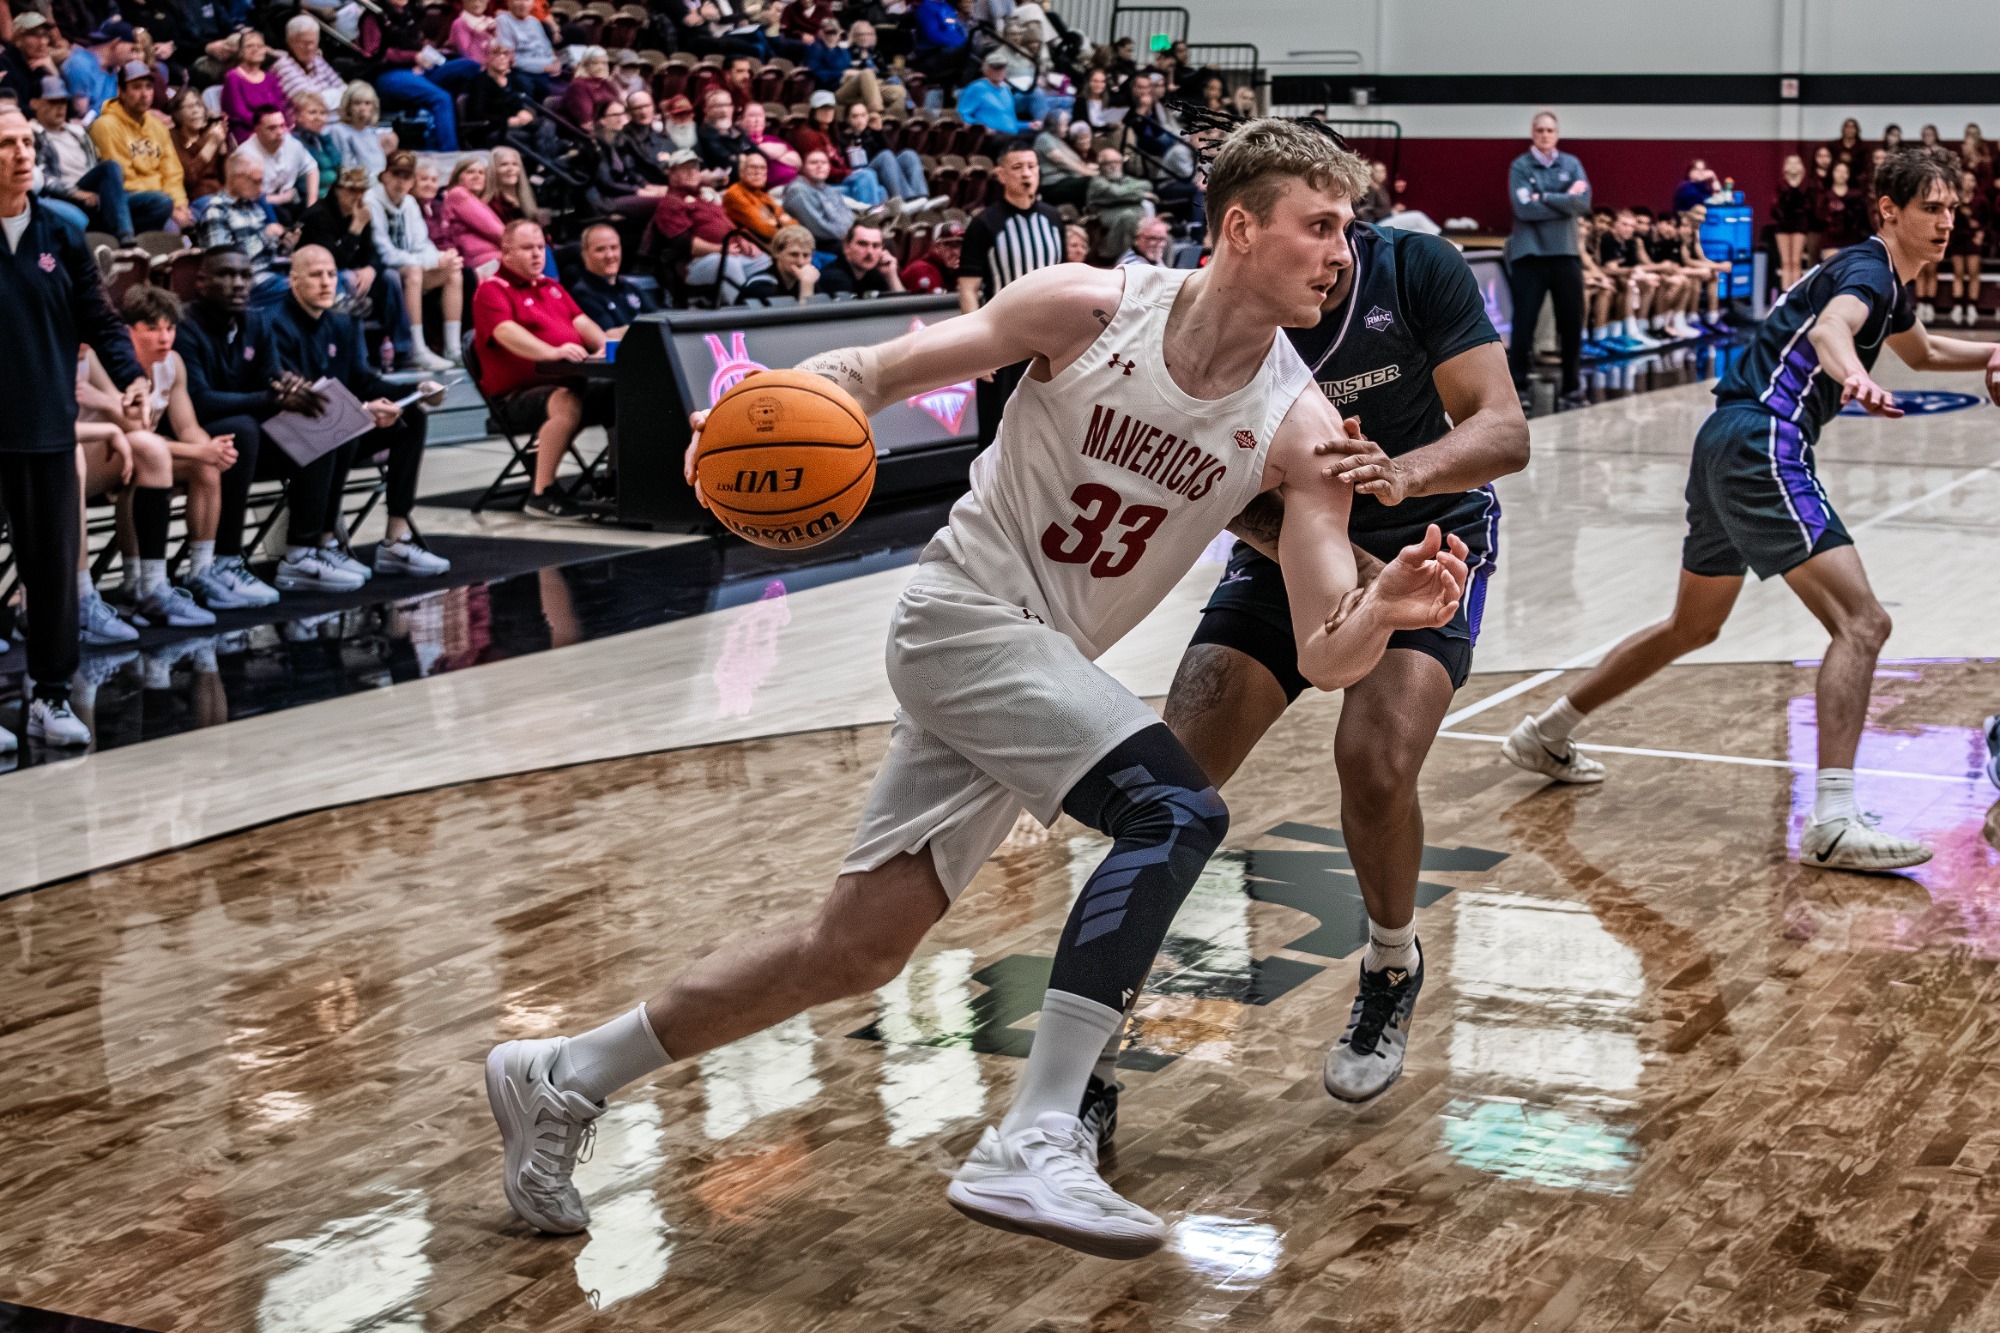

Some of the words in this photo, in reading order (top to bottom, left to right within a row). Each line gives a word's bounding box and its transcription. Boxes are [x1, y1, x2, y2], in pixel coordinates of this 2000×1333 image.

[1366, 313, 1391, 326] RMAC
[1329, 392, 1358, 407] INS
[1081, 404, 1227, 501] MAVERICKS
[733, 467, 804, 493] EVO
[723, 510, 842, 544] Wilson
[1041, 482, 1168, 578] 33
